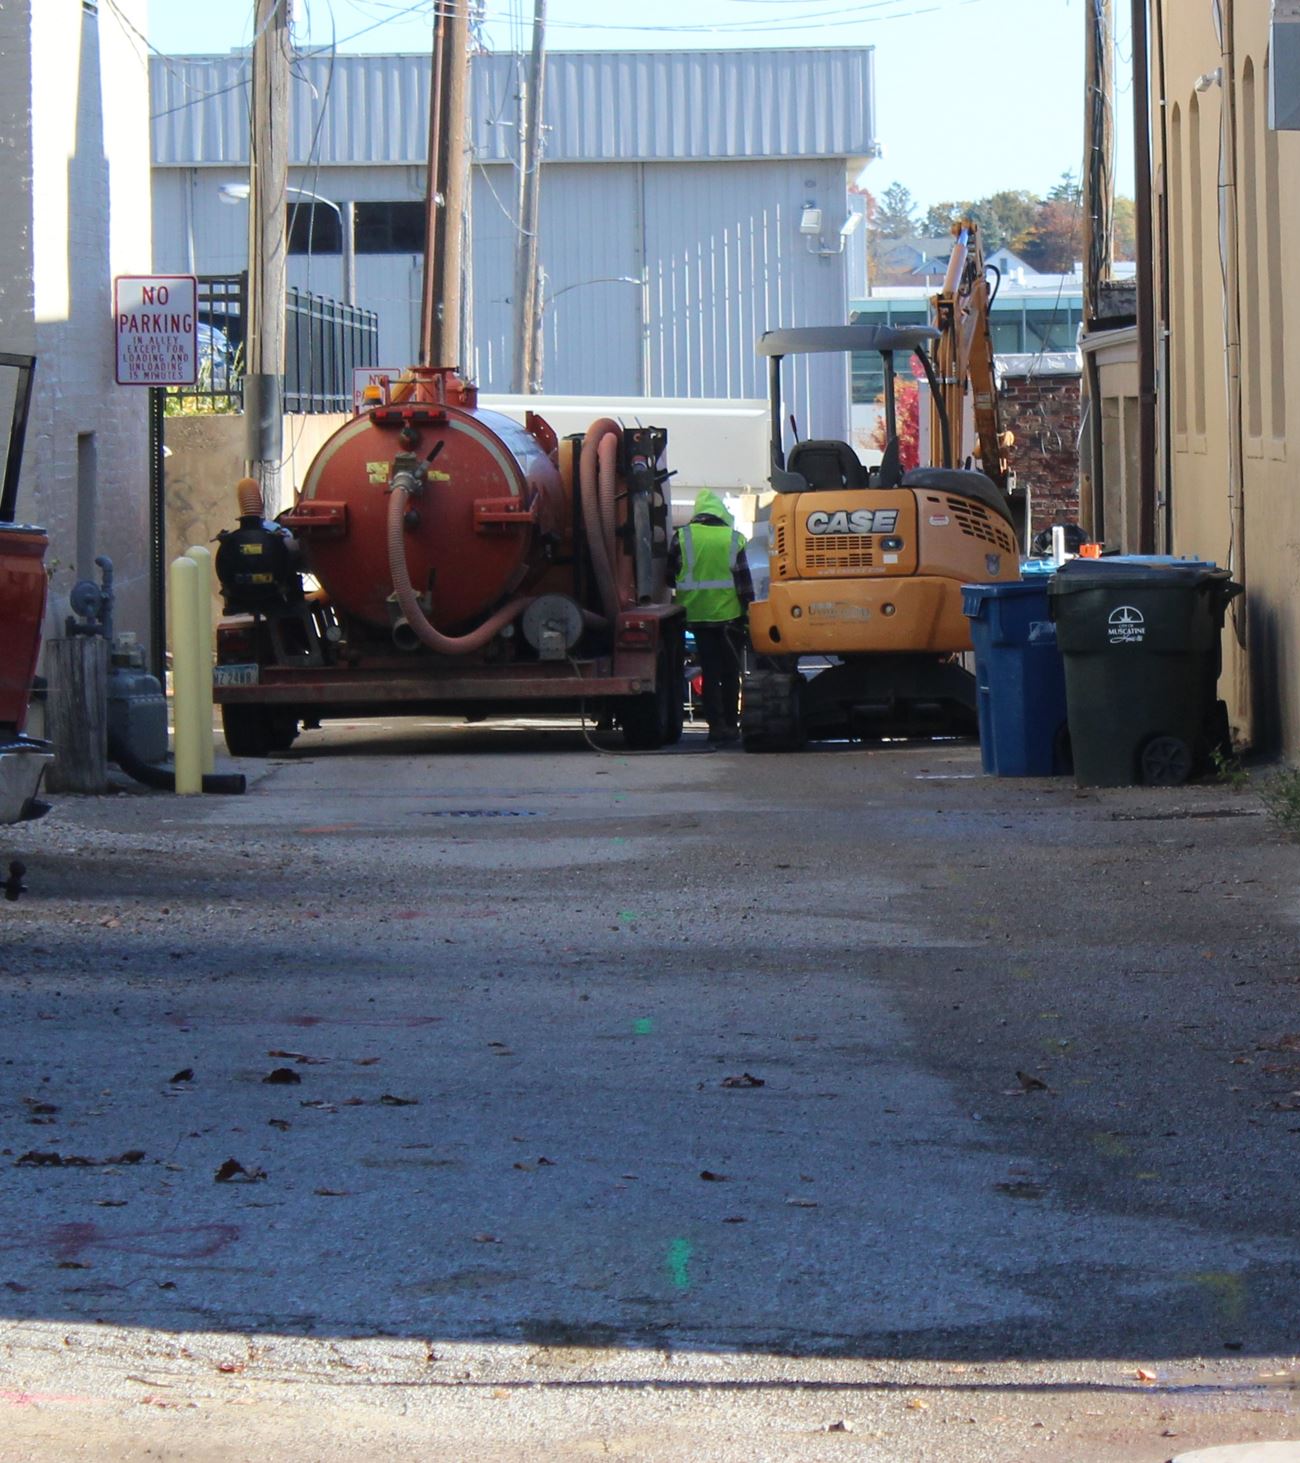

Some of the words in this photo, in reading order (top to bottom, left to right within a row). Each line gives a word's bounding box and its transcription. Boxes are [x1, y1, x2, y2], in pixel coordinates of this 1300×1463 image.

[142, 286, 169, 305] NO
[120, 313, 192, 333] PARKING
[133, 336, 142, 345] IN
[149, 336, 179, 345] ALLEY
[127, 345, 161, 354] EXCEPT
[167, 345, 185, 354] FOR
[123, 353, 164, 362] LOADING
[171, 353, 189, 362] AND
[129, 362, 183, 371] UNLOADING
[144, 371, 184, 379] MINUTES
[806, 508, 899, 535] CASE
